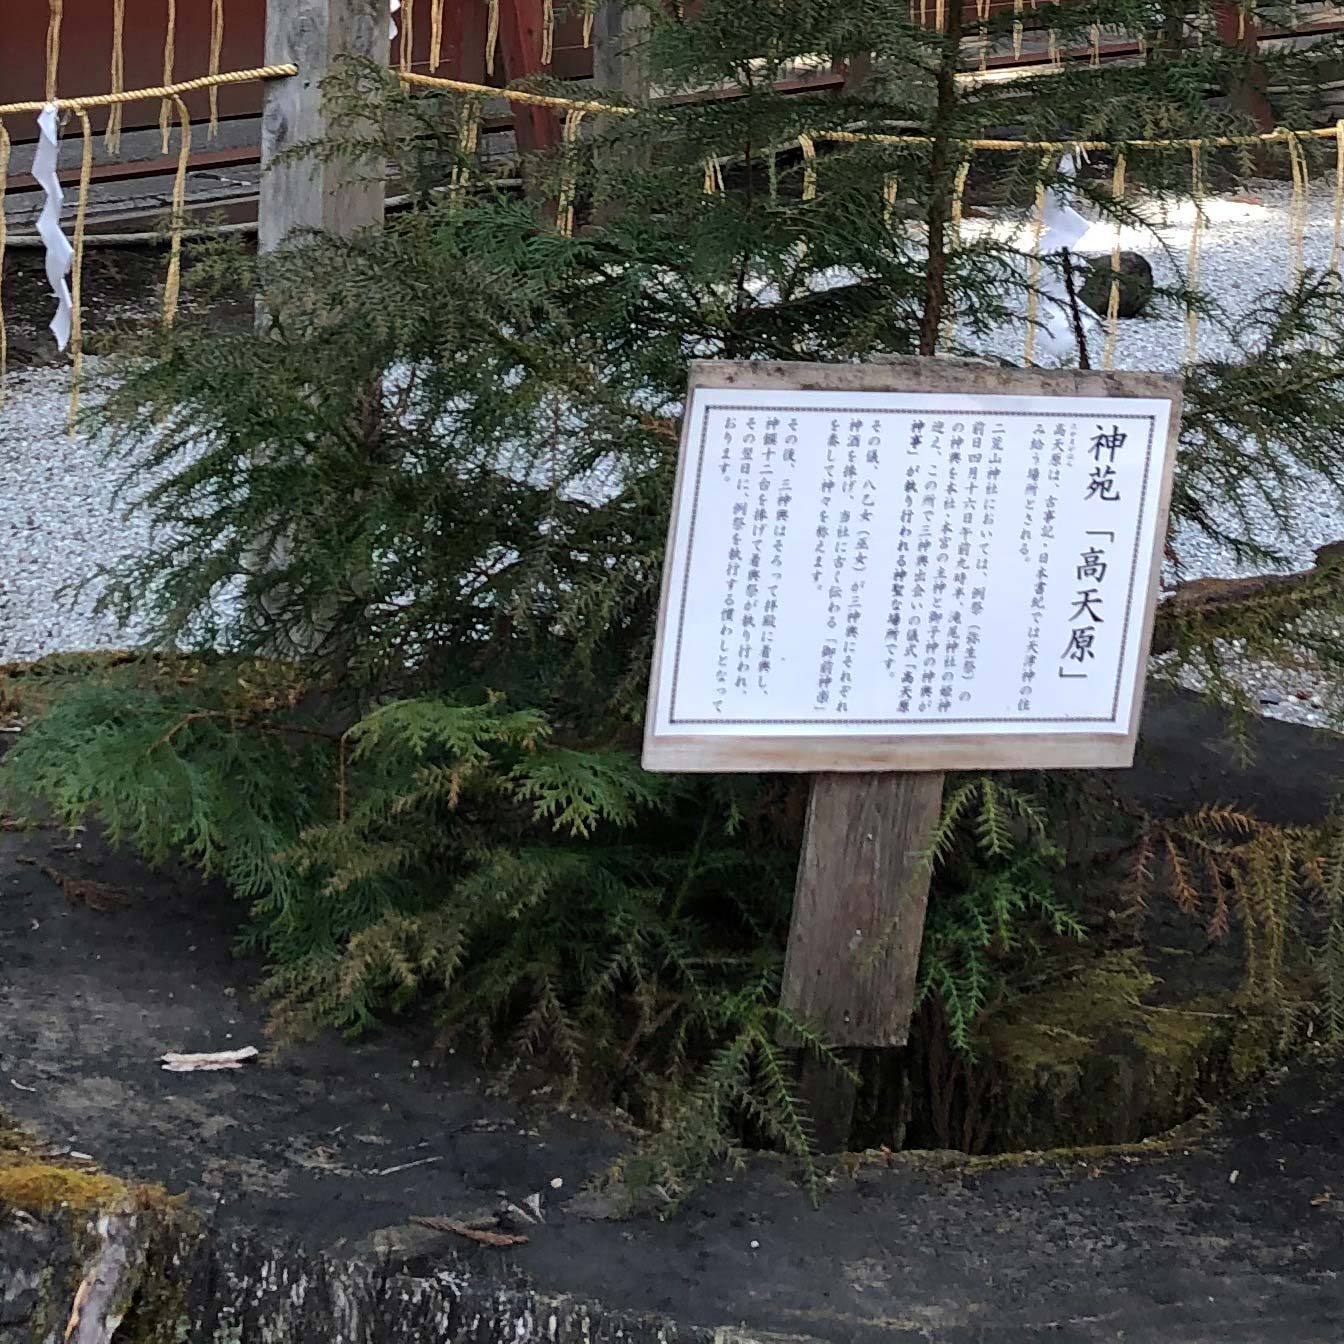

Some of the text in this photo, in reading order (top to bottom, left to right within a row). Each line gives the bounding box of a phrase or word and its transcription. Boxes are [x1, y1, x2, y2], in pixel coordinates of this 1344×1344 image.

[719, 416, 736, 483] おります。
[1057, 423, 1128, 680] 神苑「高天原」
